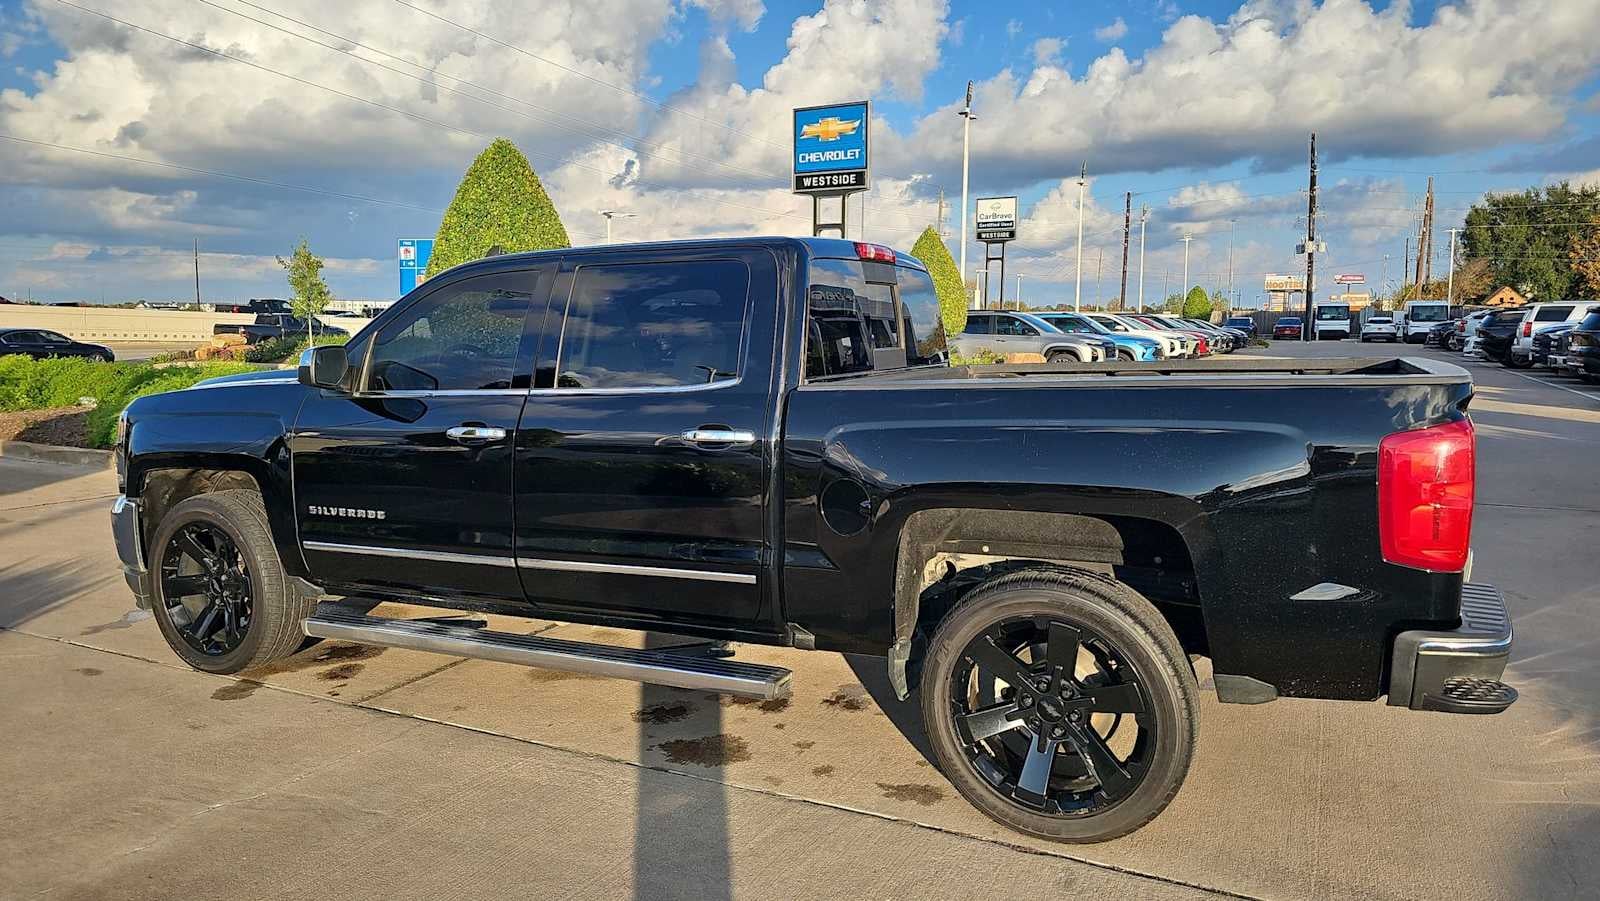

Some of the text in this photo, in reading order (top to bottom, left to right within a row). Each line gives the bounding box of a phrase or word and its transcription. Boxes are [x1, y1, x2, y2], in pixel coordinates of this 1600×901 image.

[798, 149, 861, 163] CHEVROLET
[803, 174, 856, 187] WESTSIDE
[979, 212, 1012, 220] CarBravo
[308, 505, 386, 519] SILVERADO
